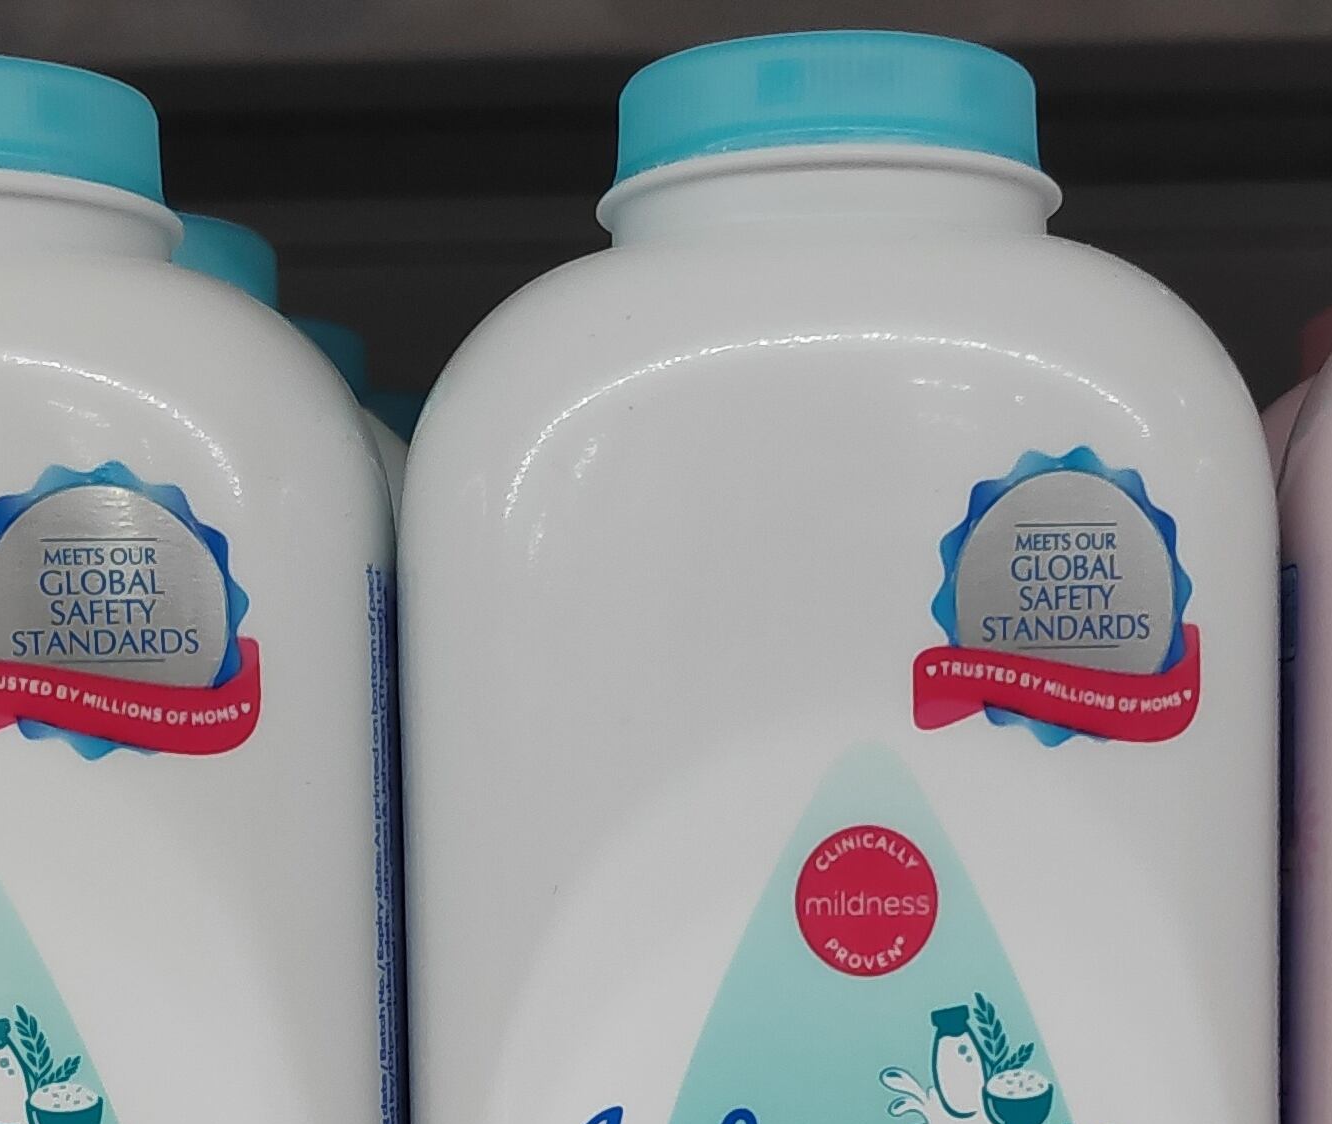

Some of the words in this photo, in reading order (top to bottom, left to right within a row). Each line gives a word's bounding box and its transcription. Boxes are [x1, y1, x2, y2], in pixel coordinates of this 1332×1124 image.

[1015, 533, 1071, 551] MEETS
[1075, 532, 1117, 550] OUR
[44, 548, 104, 566] MEETS
[110, 548, 157, 566] OUR
[1010, 554, 1123, 582] GLOBAL
[39, 569, 165, 597] GLOBAL
[1019, 584, 1116, 611] SAFETY
[50, 599, 156, 626] SAFETY
[981, 613, 1150, 642] STANDARDS
[12, 628, 199, 656] STANDARDS
[940, 660, 1017, 684] TRUSTED
[1019, 672, 1042, 690] BY
[1044, 680, 1115, 710] MILLIONS
[1118, 696, 1137, 712] OF
[1141, 694, 1181, 713] MOMS
[56, 685, 80, 702] BY
[82, 691, 163, 724] MILLIONS
[167, 708, 189, 725] OF
[191, 705, 239, 726] MOMS
[815, 832, 920, 872] CLINICALLY
[805, 890, 930, 917] mildness
